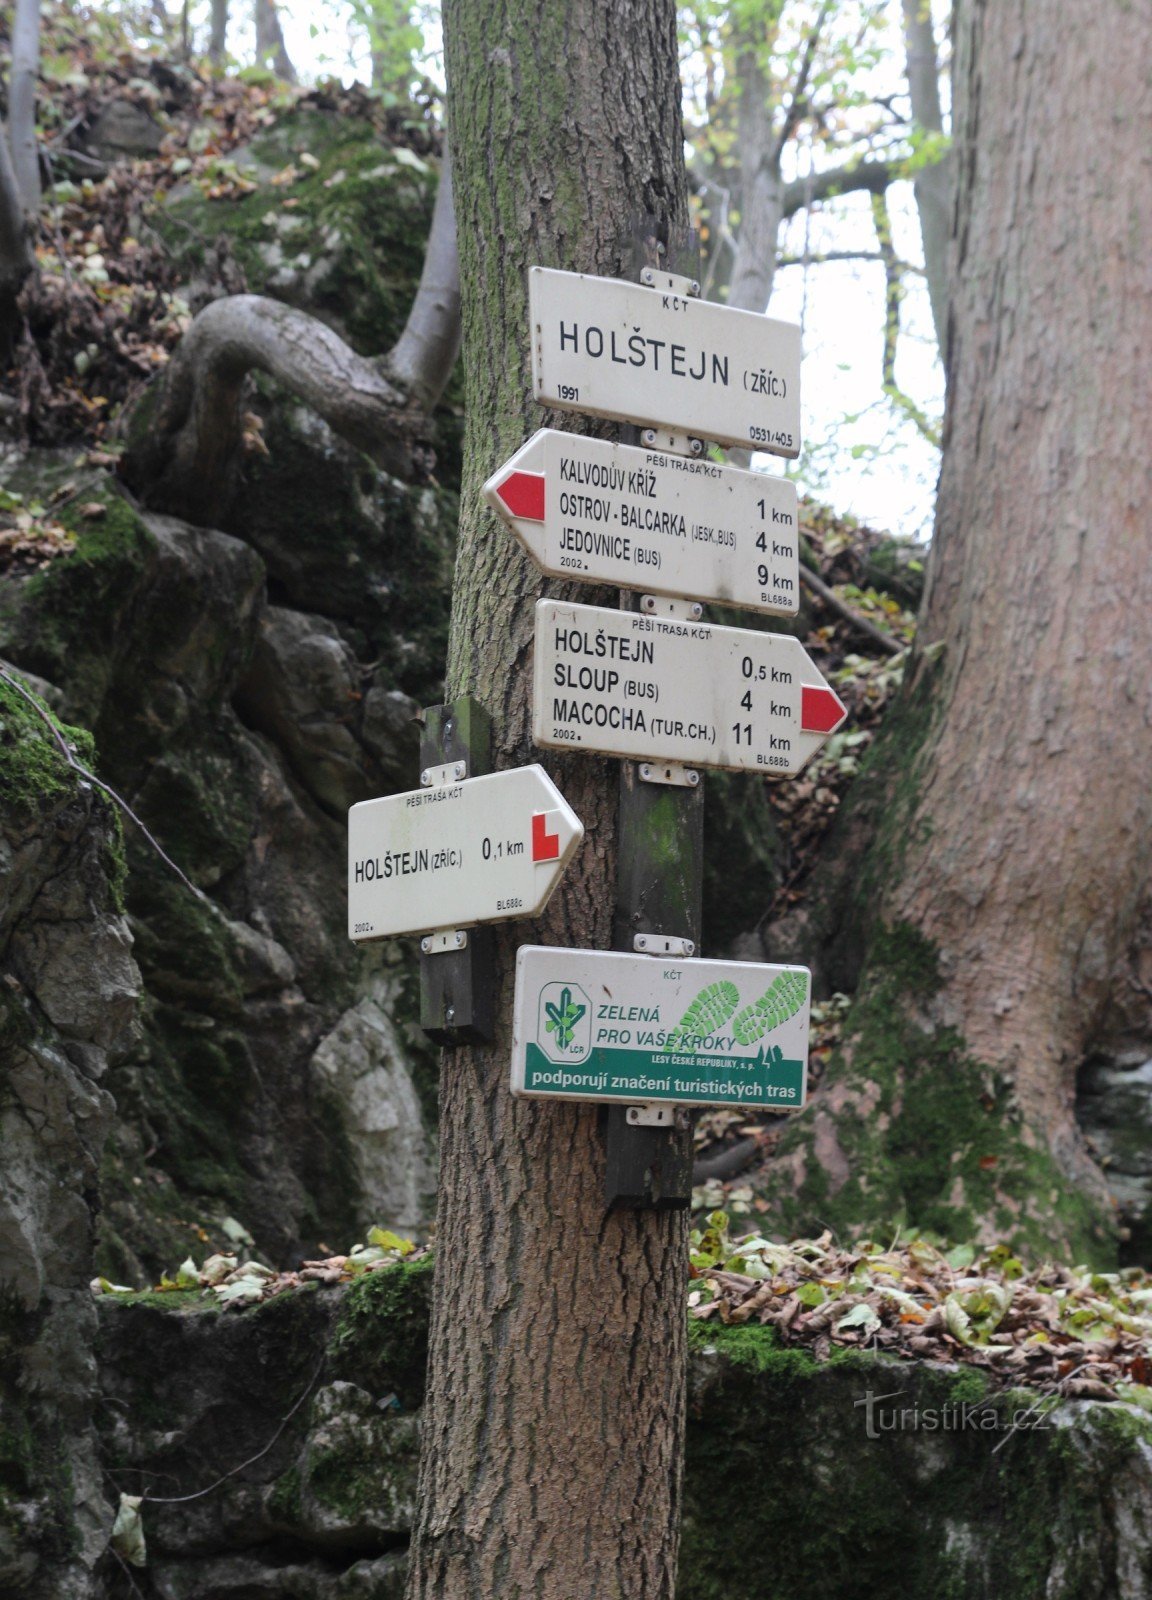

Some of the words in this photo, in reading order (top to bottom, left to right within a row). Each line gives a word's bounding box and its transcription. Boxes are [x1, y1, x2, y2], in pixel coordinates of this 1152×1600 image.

[663, 296, 688, 312] KČT
[560, 320, 729, 387] HOLŠTEJN
[743, 368, 787, 398] (ZŘÍC.)
[557, 384, 579, 402] 1991
[560, 458, 626, 491] KALVODŮV
[629, 468, 657, 498] KŘÍŽ
[646, 454, 668, 467] PĚŠÍ
[671, 459, 701, 474] TRASA
[704, 466, 723, 479] KČT
[560, 492, 611, 523] OSTROV
[621, 504, 687, 538] BALCARKA
[757, 499, 766, 520] 1
[772, 507, 793, 526] km
[559, 527, 631, 561] JEDOVNICE
[633, 547, 662, 570] (BUS)
[755, 532, 768, 553] 4
[772, 539, 793, 558] km
[757, 565, 769, 586] 9
[773, 573, 793, 591] km
[761, 592, 793, 607] BL688a
[632, 618, 654, 632] PĚŠÍ
[657, 623, 688, 637] TRASA
[691, 628, 711, 640] KČT
[555, 628, 654, 664] HOLŠTEJN
[741, 656, 766, 682] 0,5
[771, 667, 792, 684] km
[554, 663, 619, 693] SLOUP
[623, 679, 659, 703] (BUS)
[741, 690, 753, 712] 4
[770, 701, 791, 718] km
[553, 698, 646, 732] MACOCHA
[650, 718, 716, 745] (TUR.CH.)
[732, 723, 752, 746] 11
[769, 734, 791, 751] km
[757, 754, 790, 768] BL688b
[424, 792, 447, 805] TRASA
[449, 787, 463, 799] KČT
[355, 848, 429, 883] HOLŠTEJN
[431, 848, 463, 874] (ZŘÍC.)
[482, 838, 503, 861] 0,1
[506, 840, 524, 856] km
[496, 898, 523, 911] BL688c
[663, 969, 682, 981] KČT
[597, 1004, 660, 1023] ZELENÁ
[597, 1029, 631, 1044] PRO
[635, 1028, 676, 1047] VAŠE
[680, 1033, 736, 1051] KROKY
[651, 1055, 670, 1064] LESY
[671, 1054, 695, 1066] ČESKÉ
[696, 1058, 739, 1070] REPUBLIKY,
[532, 1069, 608, 1090] podporují
[611, 1074, 671, 1092] značení
[674, 1078, 762, 1099] turistických
[767, 1084, 796, 1099] tras
